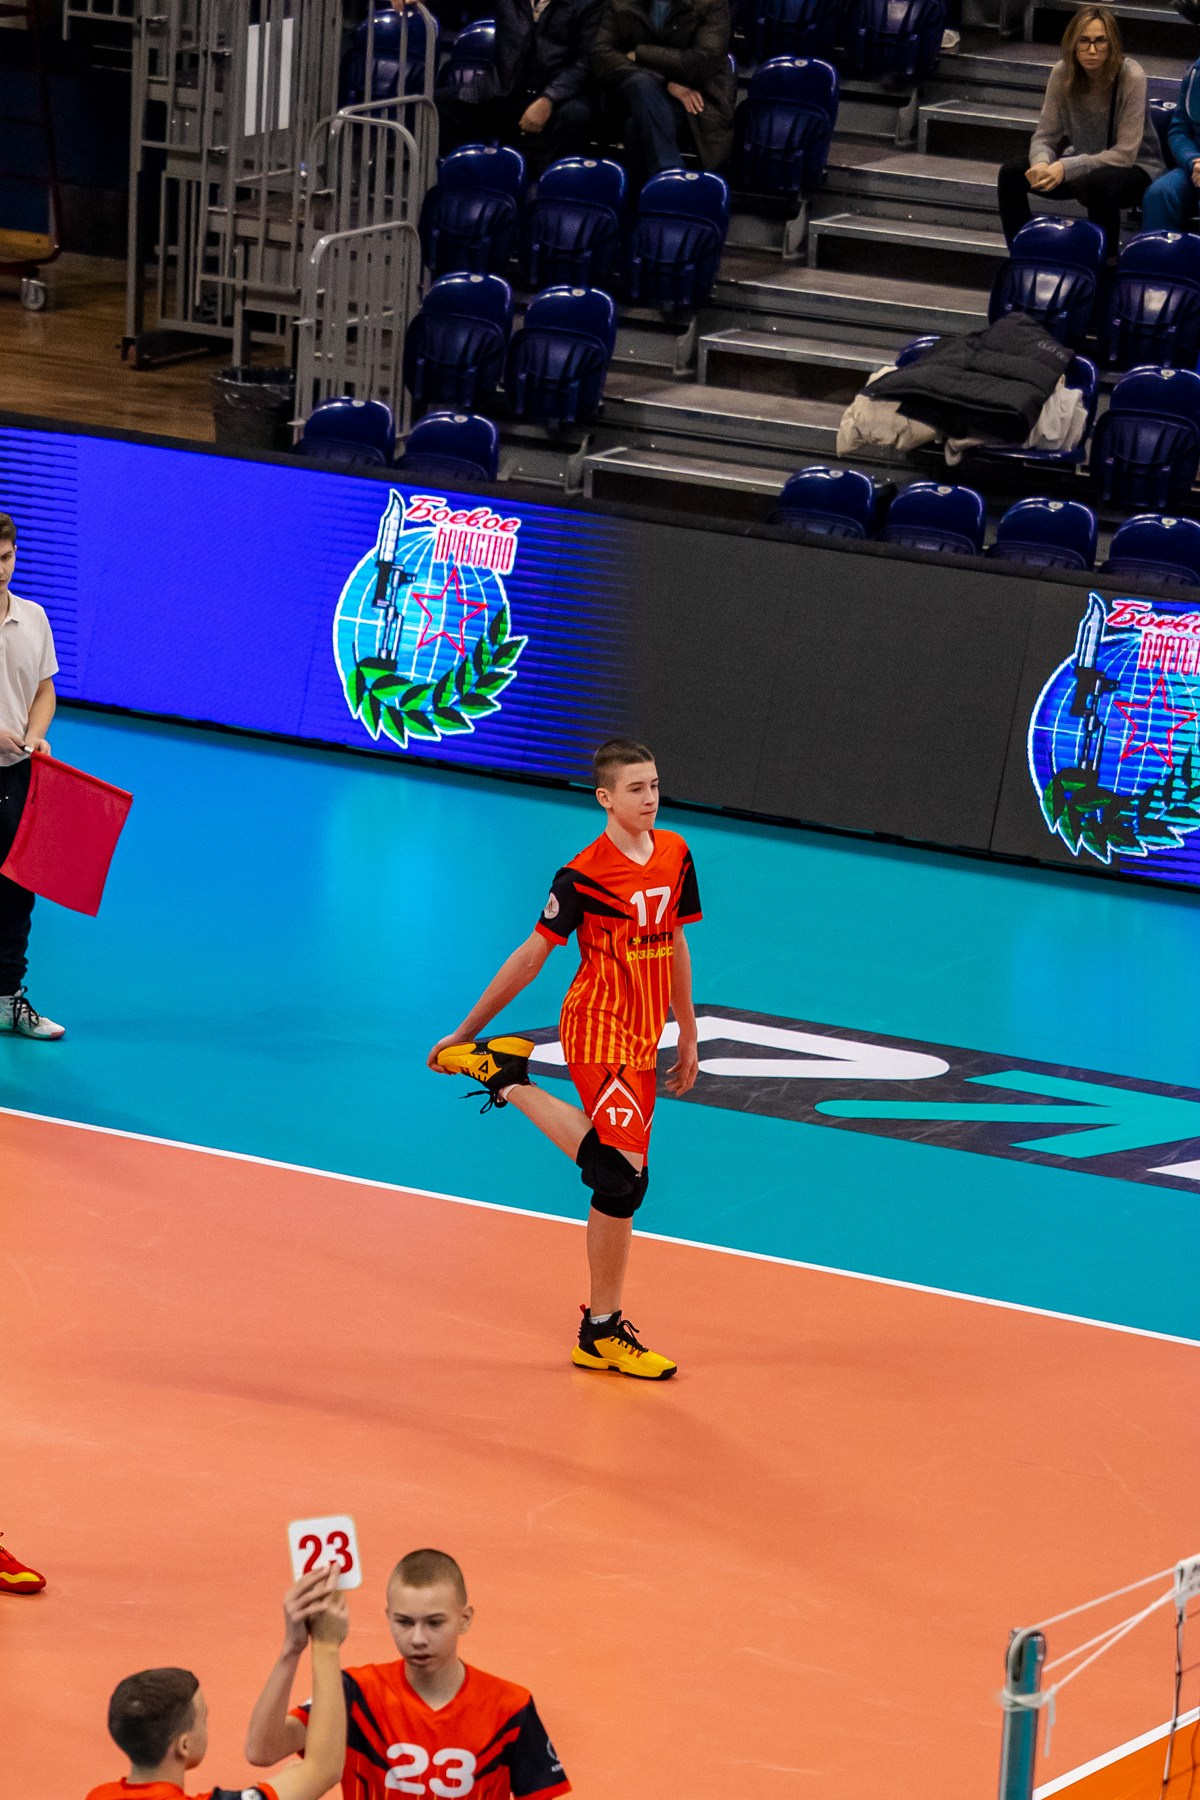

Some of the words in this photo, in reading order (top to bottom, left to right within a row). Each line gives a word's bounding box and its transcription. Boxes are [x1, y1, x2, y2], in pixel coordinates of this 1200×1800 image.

[407, 498, 519, 532] Боевое
[629, 886, 671, 927] 17
[605, 1106, 634, 1128] 17
[298, 1530, 354, 1575] 23
[384, 1742, 477, 1799] 23
